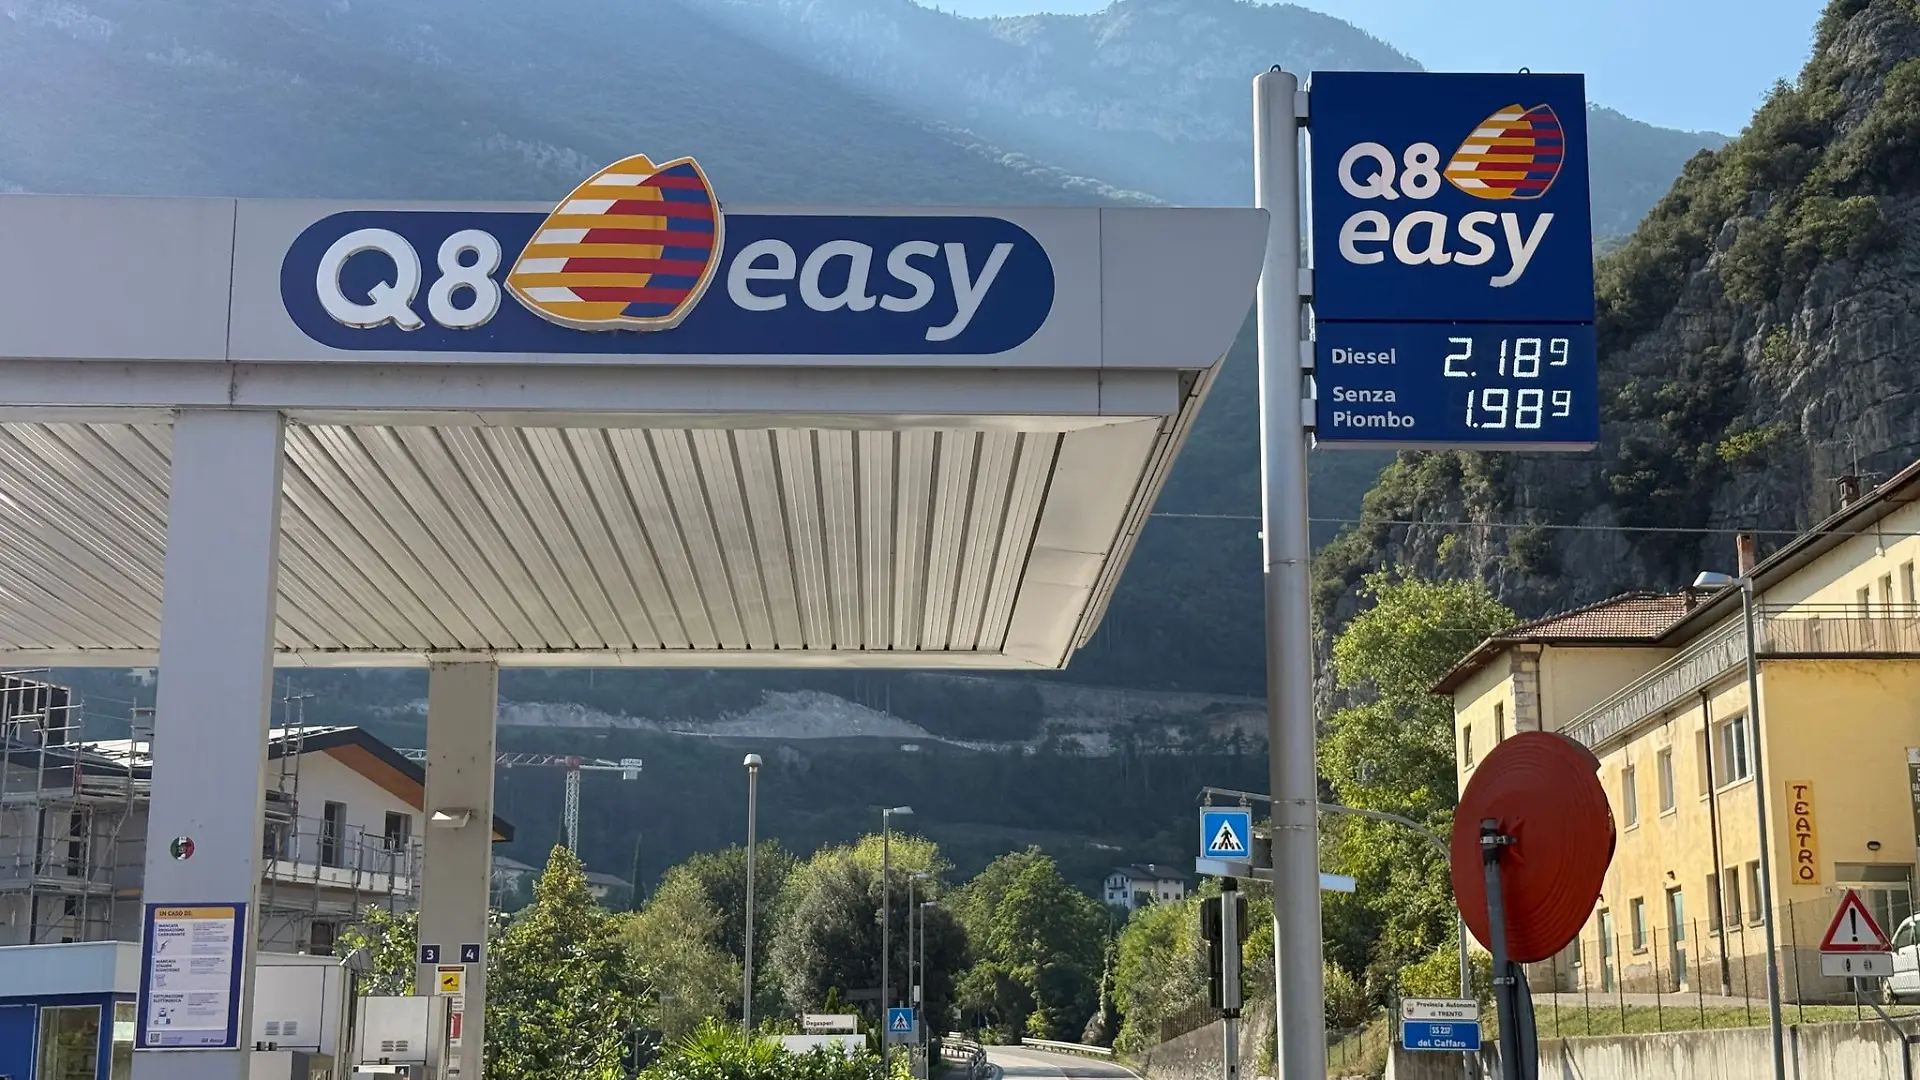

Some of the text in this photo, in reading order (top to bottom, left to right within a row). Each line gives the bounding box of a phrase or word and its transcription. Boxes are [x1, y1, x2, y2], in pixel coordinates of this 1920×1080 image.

[1338, 141, 1442, 200] Q8
[1338, 210, 1554, 288] easy
[316, 228, 1012, 341] Q8 easy
[1331, 348, 1396, 365] Diesel
[1333, 387, 1396, 403] Senza
[1333, 411, 1415, 428] Piombo
[1793, 785, 1814, 880] TEATRO
[426, 948, 474, 960] 3 4
[1432, 1026, 1440, 1034] SS
[1417, 1039, 1466, 1047] del Caffaro
